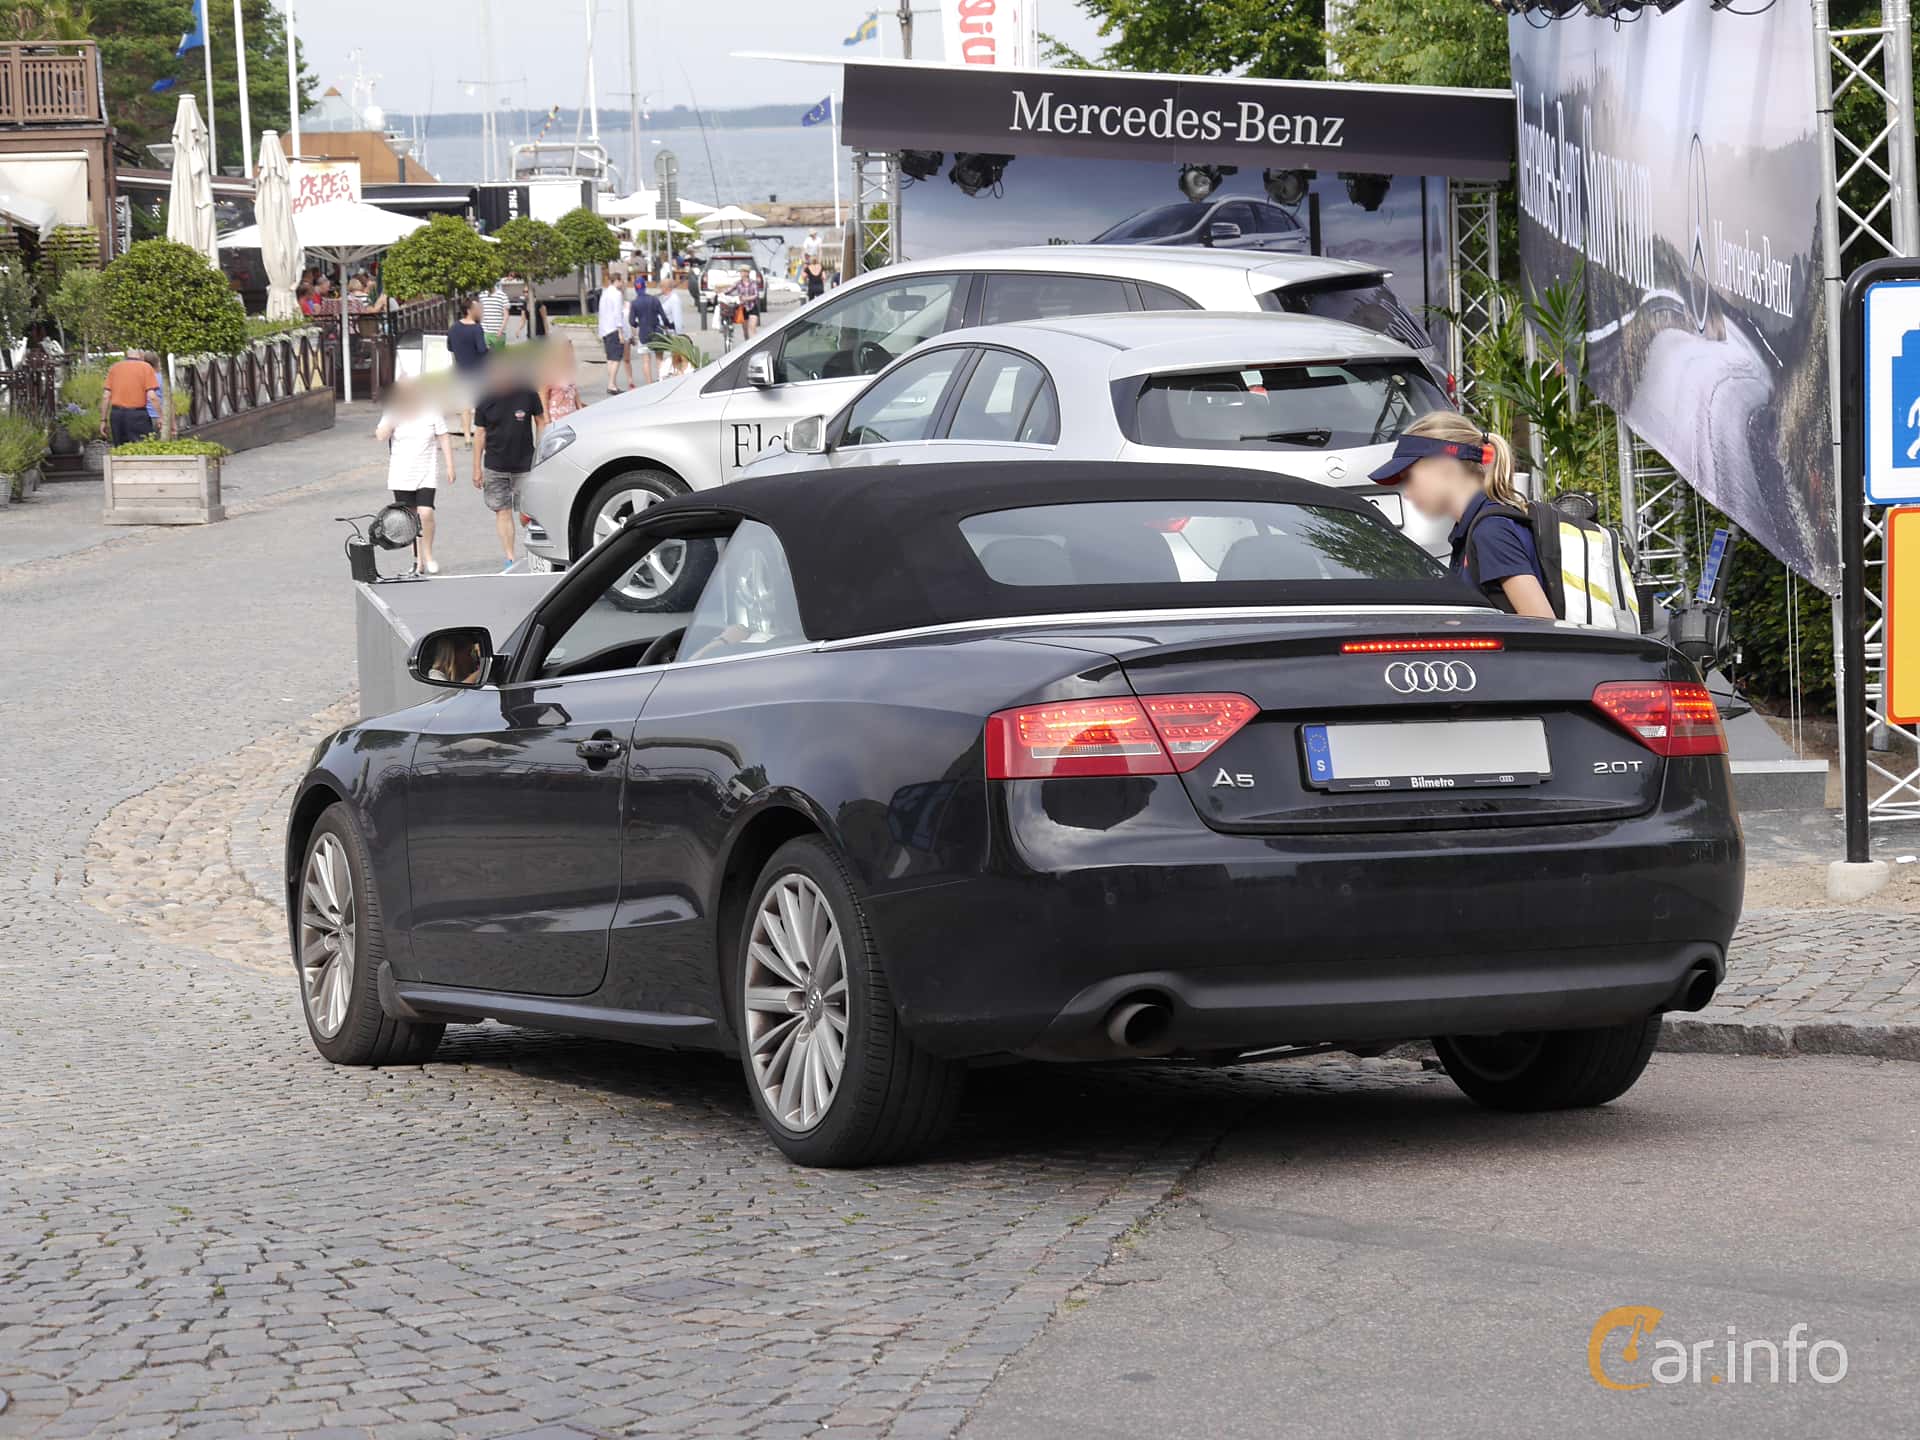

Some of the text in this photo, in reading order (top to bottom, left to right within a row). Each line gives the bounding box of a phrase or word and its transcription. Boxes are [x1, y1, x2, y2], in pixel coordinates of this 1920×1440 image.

[1009, 90, 1345, 147] Mercedes-Benz
[1515, 80, 1655, 290] Mercedes-Benz Showroom
[1713, 218, 1793, 318] Mercedes-Benz
[1316, 759, 1327, 772] S
[1593, 760, 1643, 774] 2.0T
[1211, 767, 1255, 788] A5
[1410, 776, 1455, 789] Bilmetro
